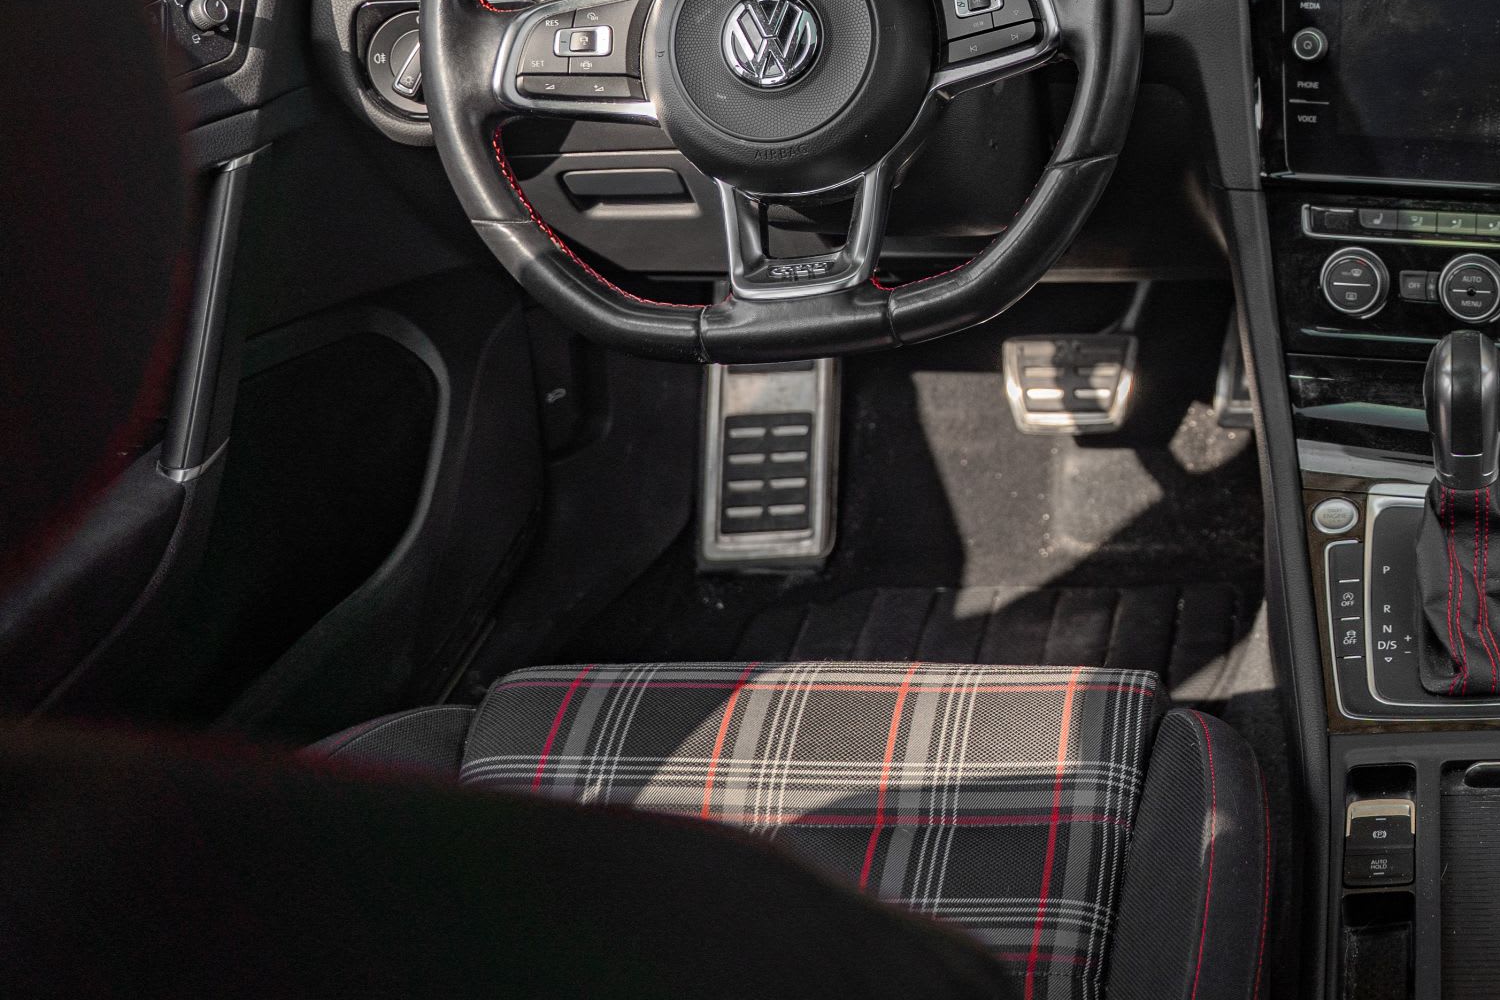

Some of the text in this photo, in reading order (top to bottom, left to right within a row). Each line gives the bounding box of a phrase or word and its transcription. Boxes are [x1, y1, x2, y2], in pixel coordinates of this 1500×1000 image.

[1300, 2, 1321, 10] MEDIA
[545, 19, 560, 27] RES
[531, 60, 545, 68] SET
[1296, 80, 1320, 89] PHONE
[1297, 114, 1317, 123] VOICE
[754, 142, 810, 161] AIRBAG
[1462, 275, 1482, 283] AUTO
[1461, 300, 1482, 308] MENU
[1382, 565, 1391, 575] P
[1340, 600, 1355, 608] OFF
[1383, 604, 1391, 614] R
[1382, 624, 1393, 634] N
[1342, 638, 1358, 646] OFF
[1377, 640, 1398, 650] D/S
